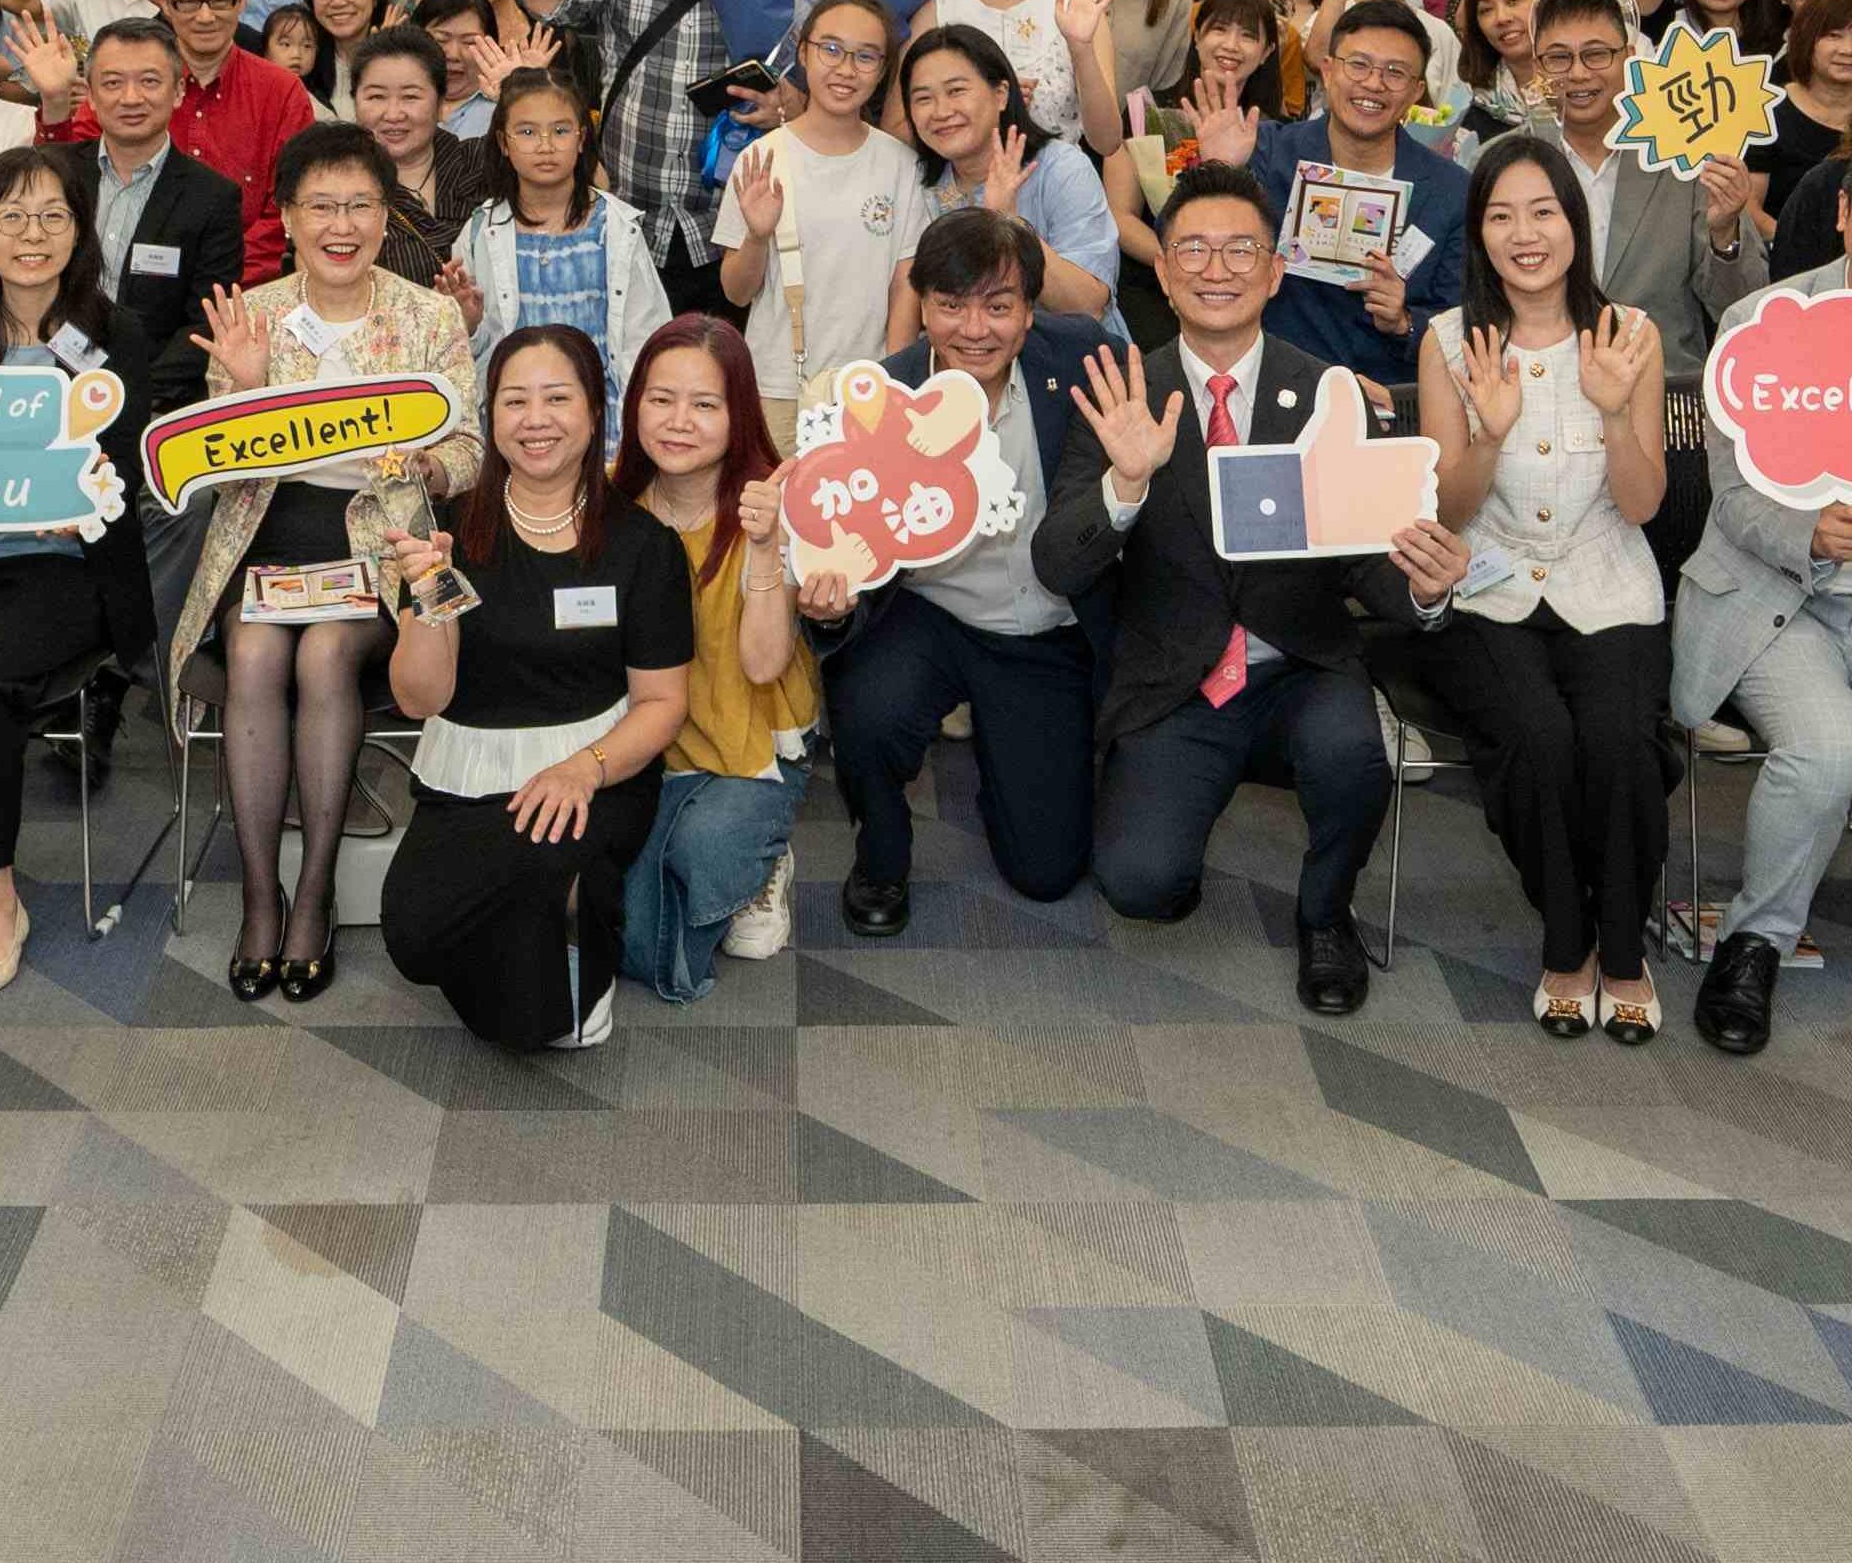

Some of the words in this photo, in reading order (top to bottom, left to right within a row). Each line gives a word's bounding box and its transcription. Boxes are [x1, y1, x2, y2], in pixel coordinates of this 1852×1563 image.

[1659, 61, 1736, 144] 勁
[9, 390, 50, 419] of
[204, 398, 393, 467] Excellent!
[810, 467, 955, 545] 加油
